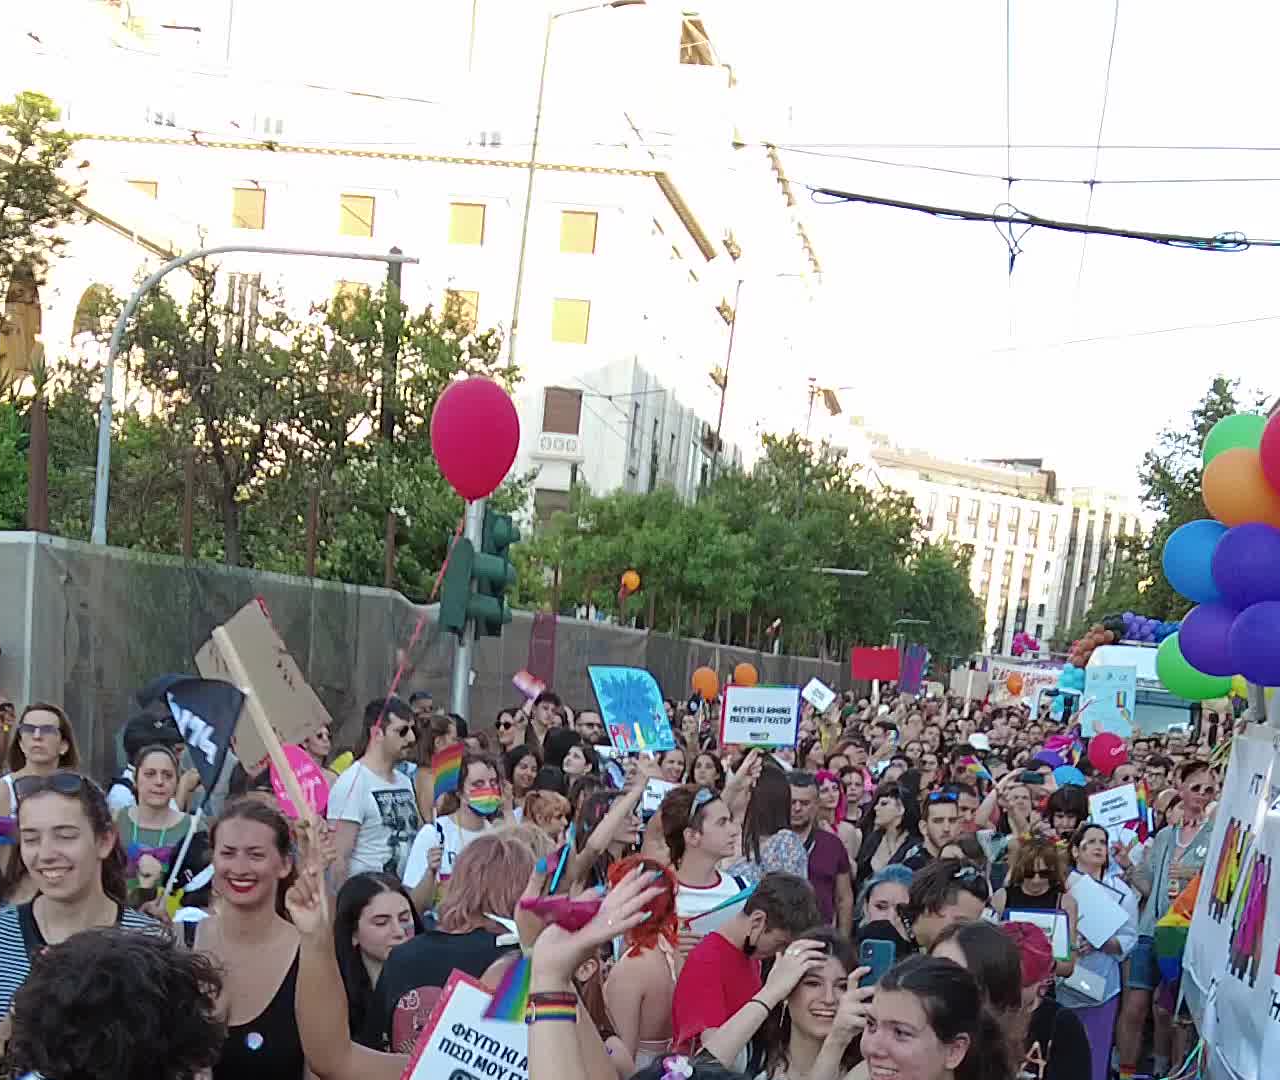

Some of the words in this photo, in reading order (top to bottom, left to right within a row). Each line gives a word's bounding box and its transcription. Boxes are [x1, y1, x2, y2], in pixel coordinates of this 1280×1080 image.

[437, 1037, 472, 1065] ΠΙΣΩ
[472, 1056, 508, 1080] ΜΟΥ
[451, 1021, 501, 1056] ΦΕΥΓΩ
[501, 1047, 520, 1065] ΚΙ
